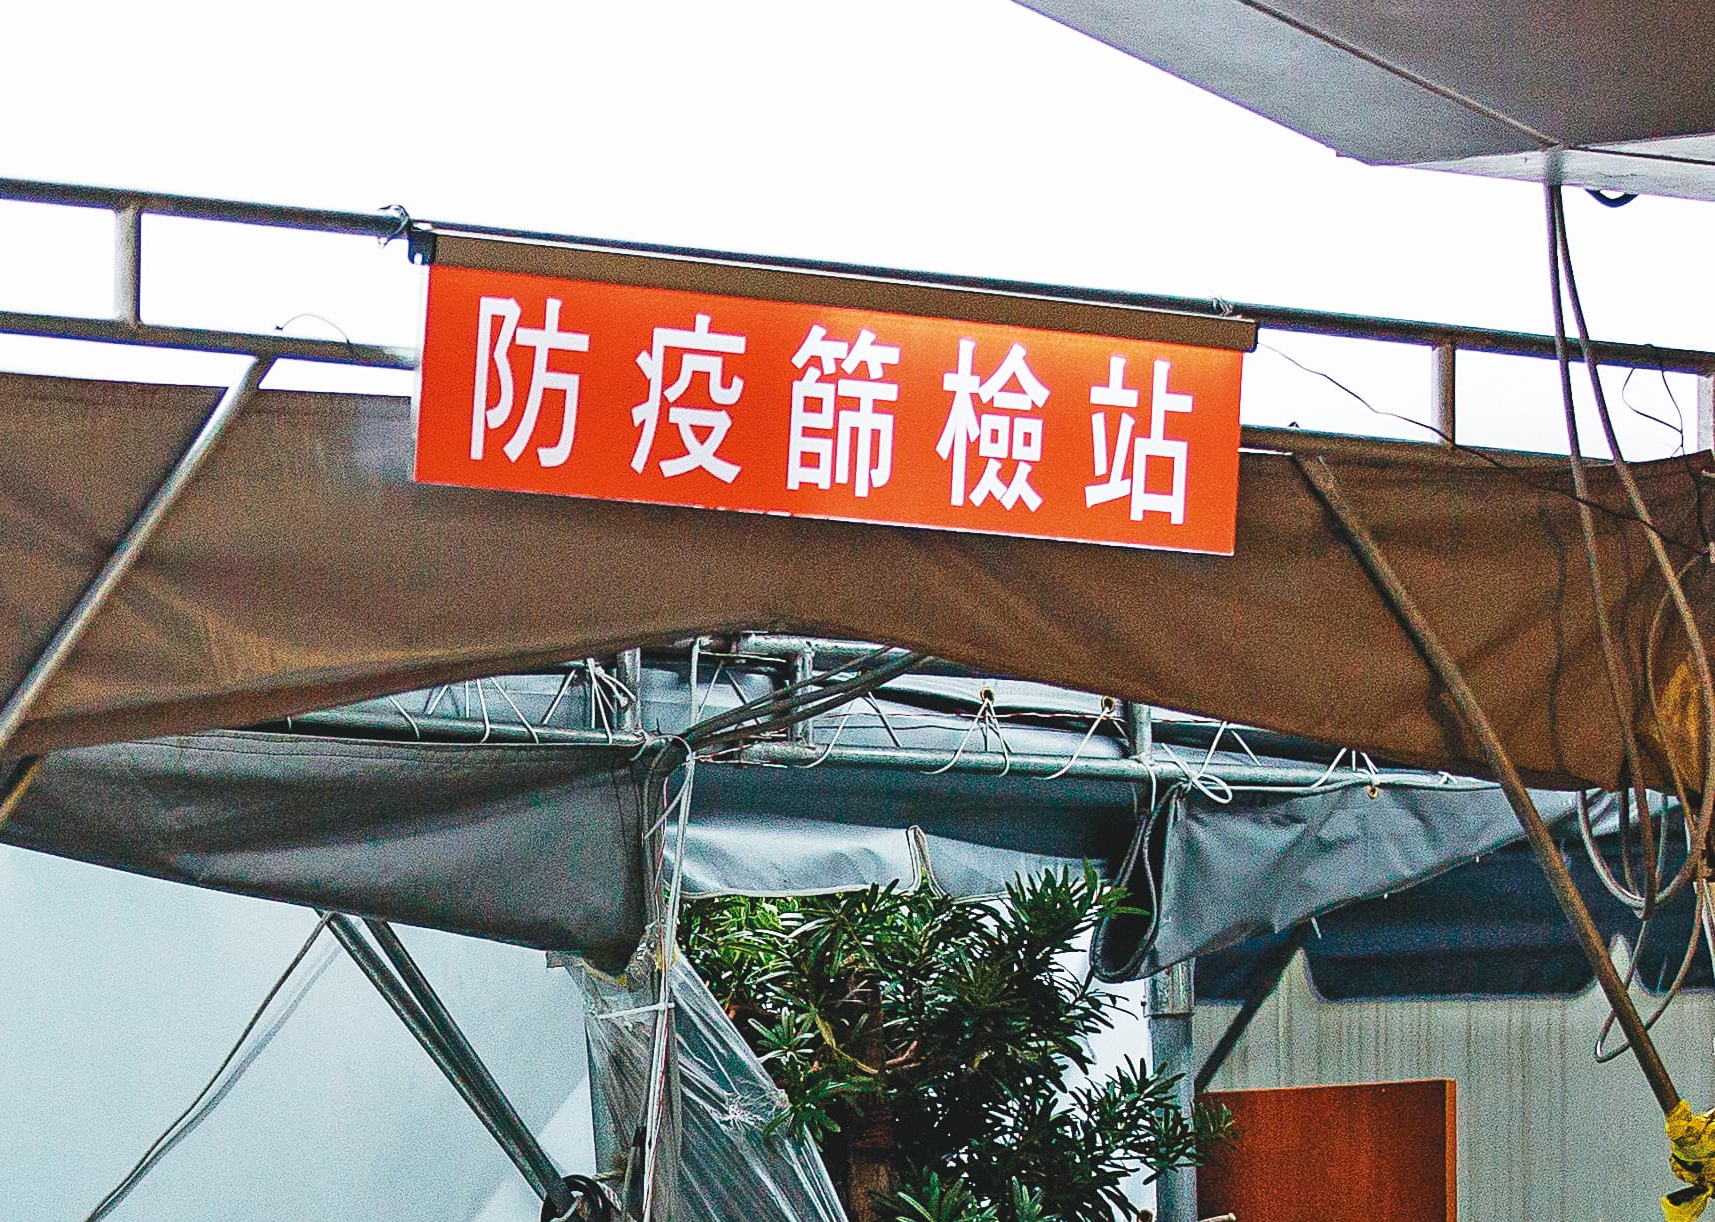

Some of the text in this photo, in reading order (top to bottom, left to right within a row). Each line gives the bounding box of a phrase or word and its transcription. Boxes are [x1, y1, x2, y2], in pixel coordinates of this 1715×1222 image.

[469, 295, 1194, 526] 防疫篩檢站
